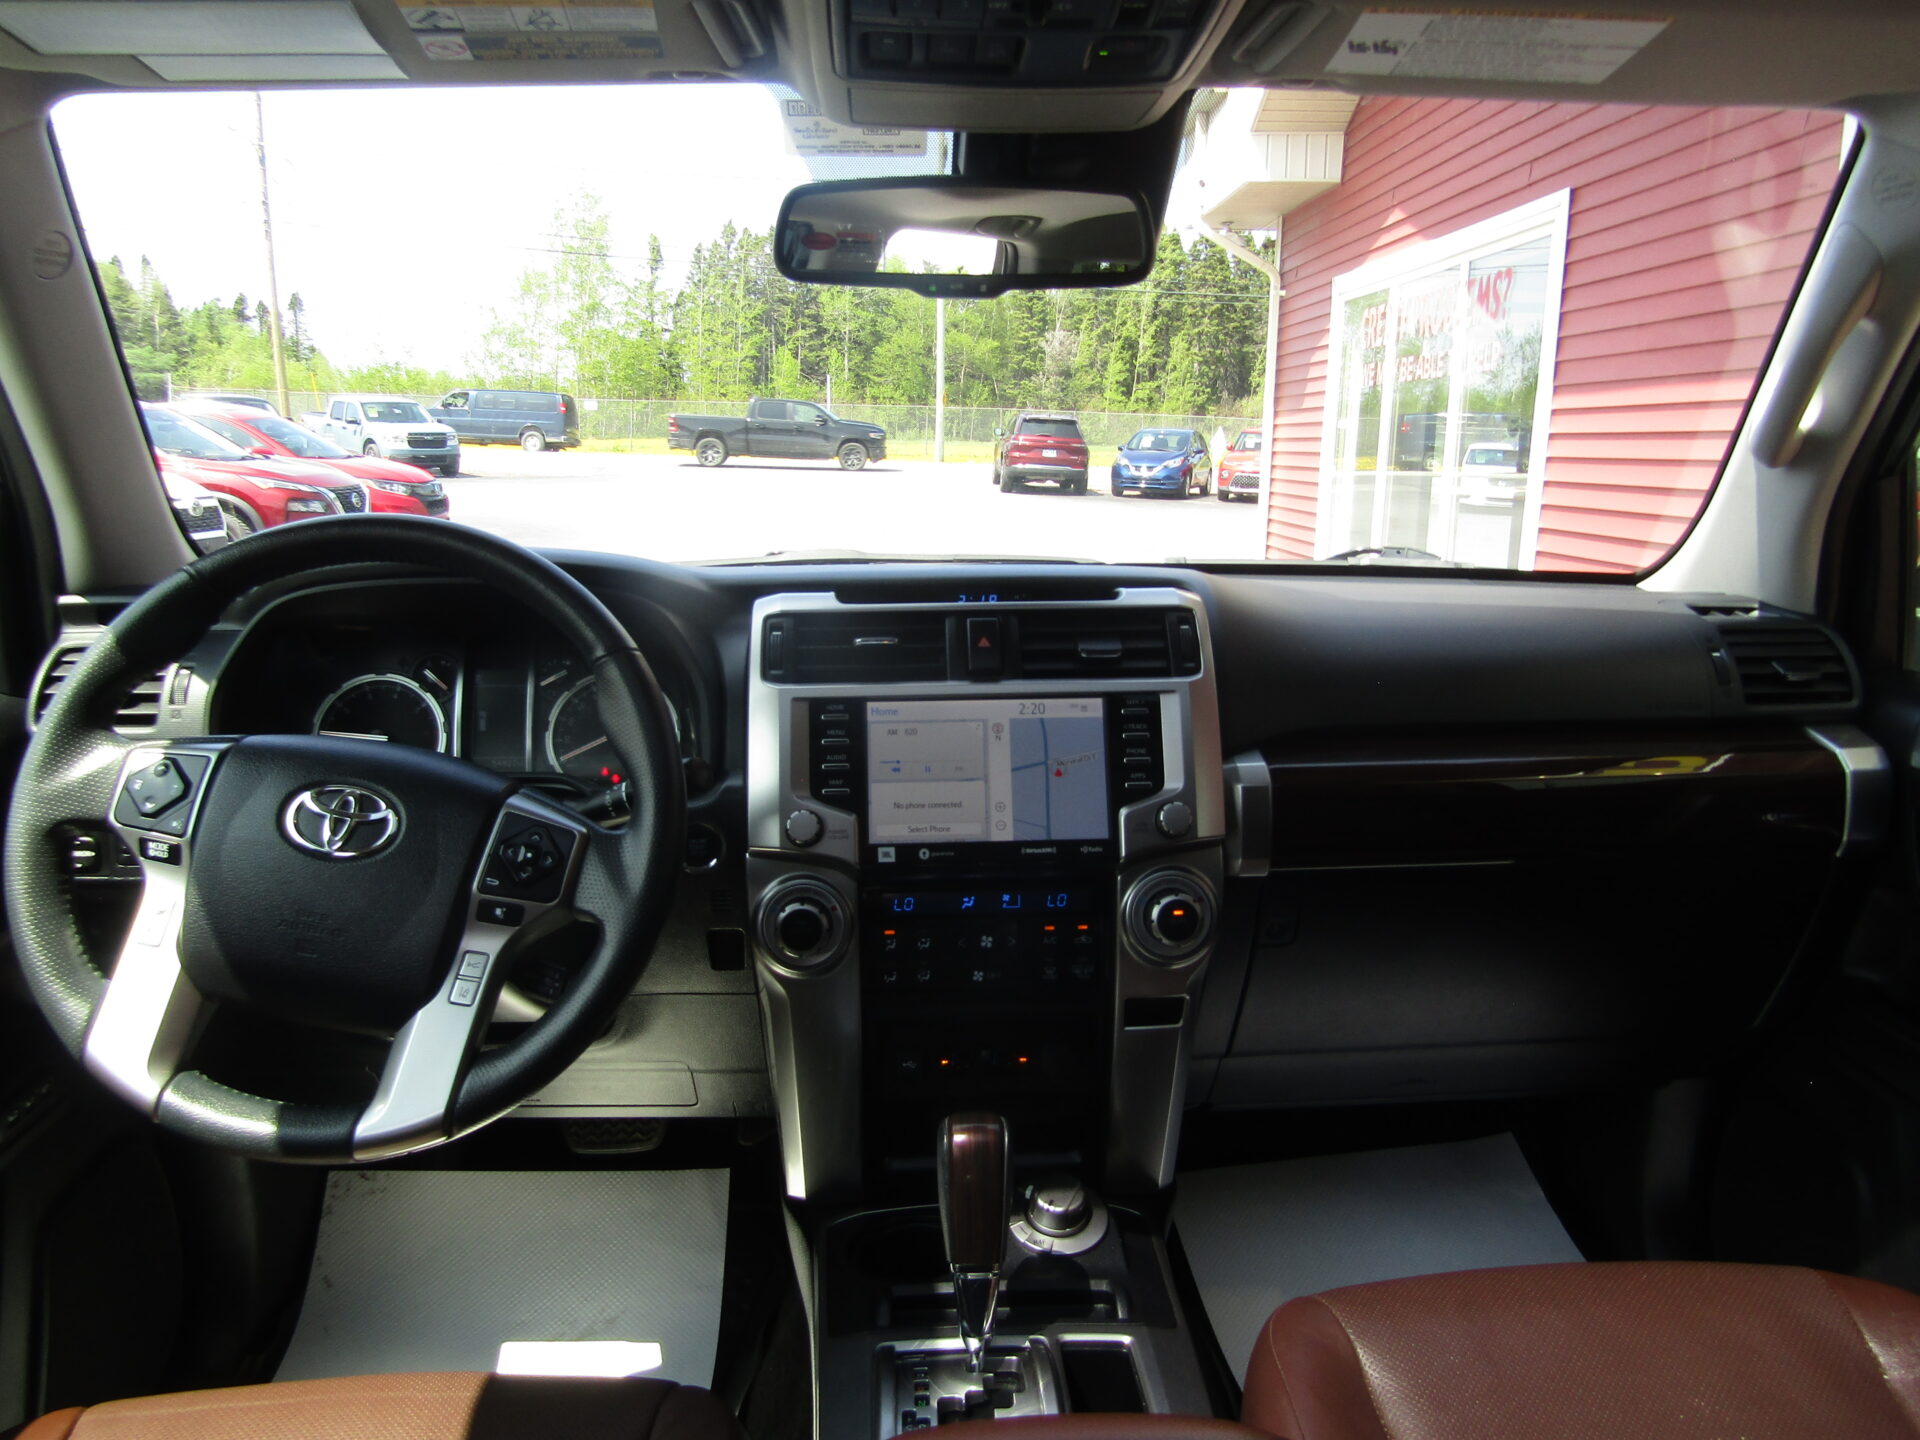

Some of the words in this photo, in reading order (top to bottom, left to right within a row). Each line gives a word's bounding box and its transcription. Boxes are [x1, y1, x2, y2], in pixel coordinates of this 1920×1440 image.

[871, 707, 898, 716] Home
[1019, 703, 1046, 715] 2:20
[905, 802, 926, 810] phone
[928, 801, 962, 809] connected
[907, 825, 928, 833] Select
[929, 825, 951, 833] Phone
